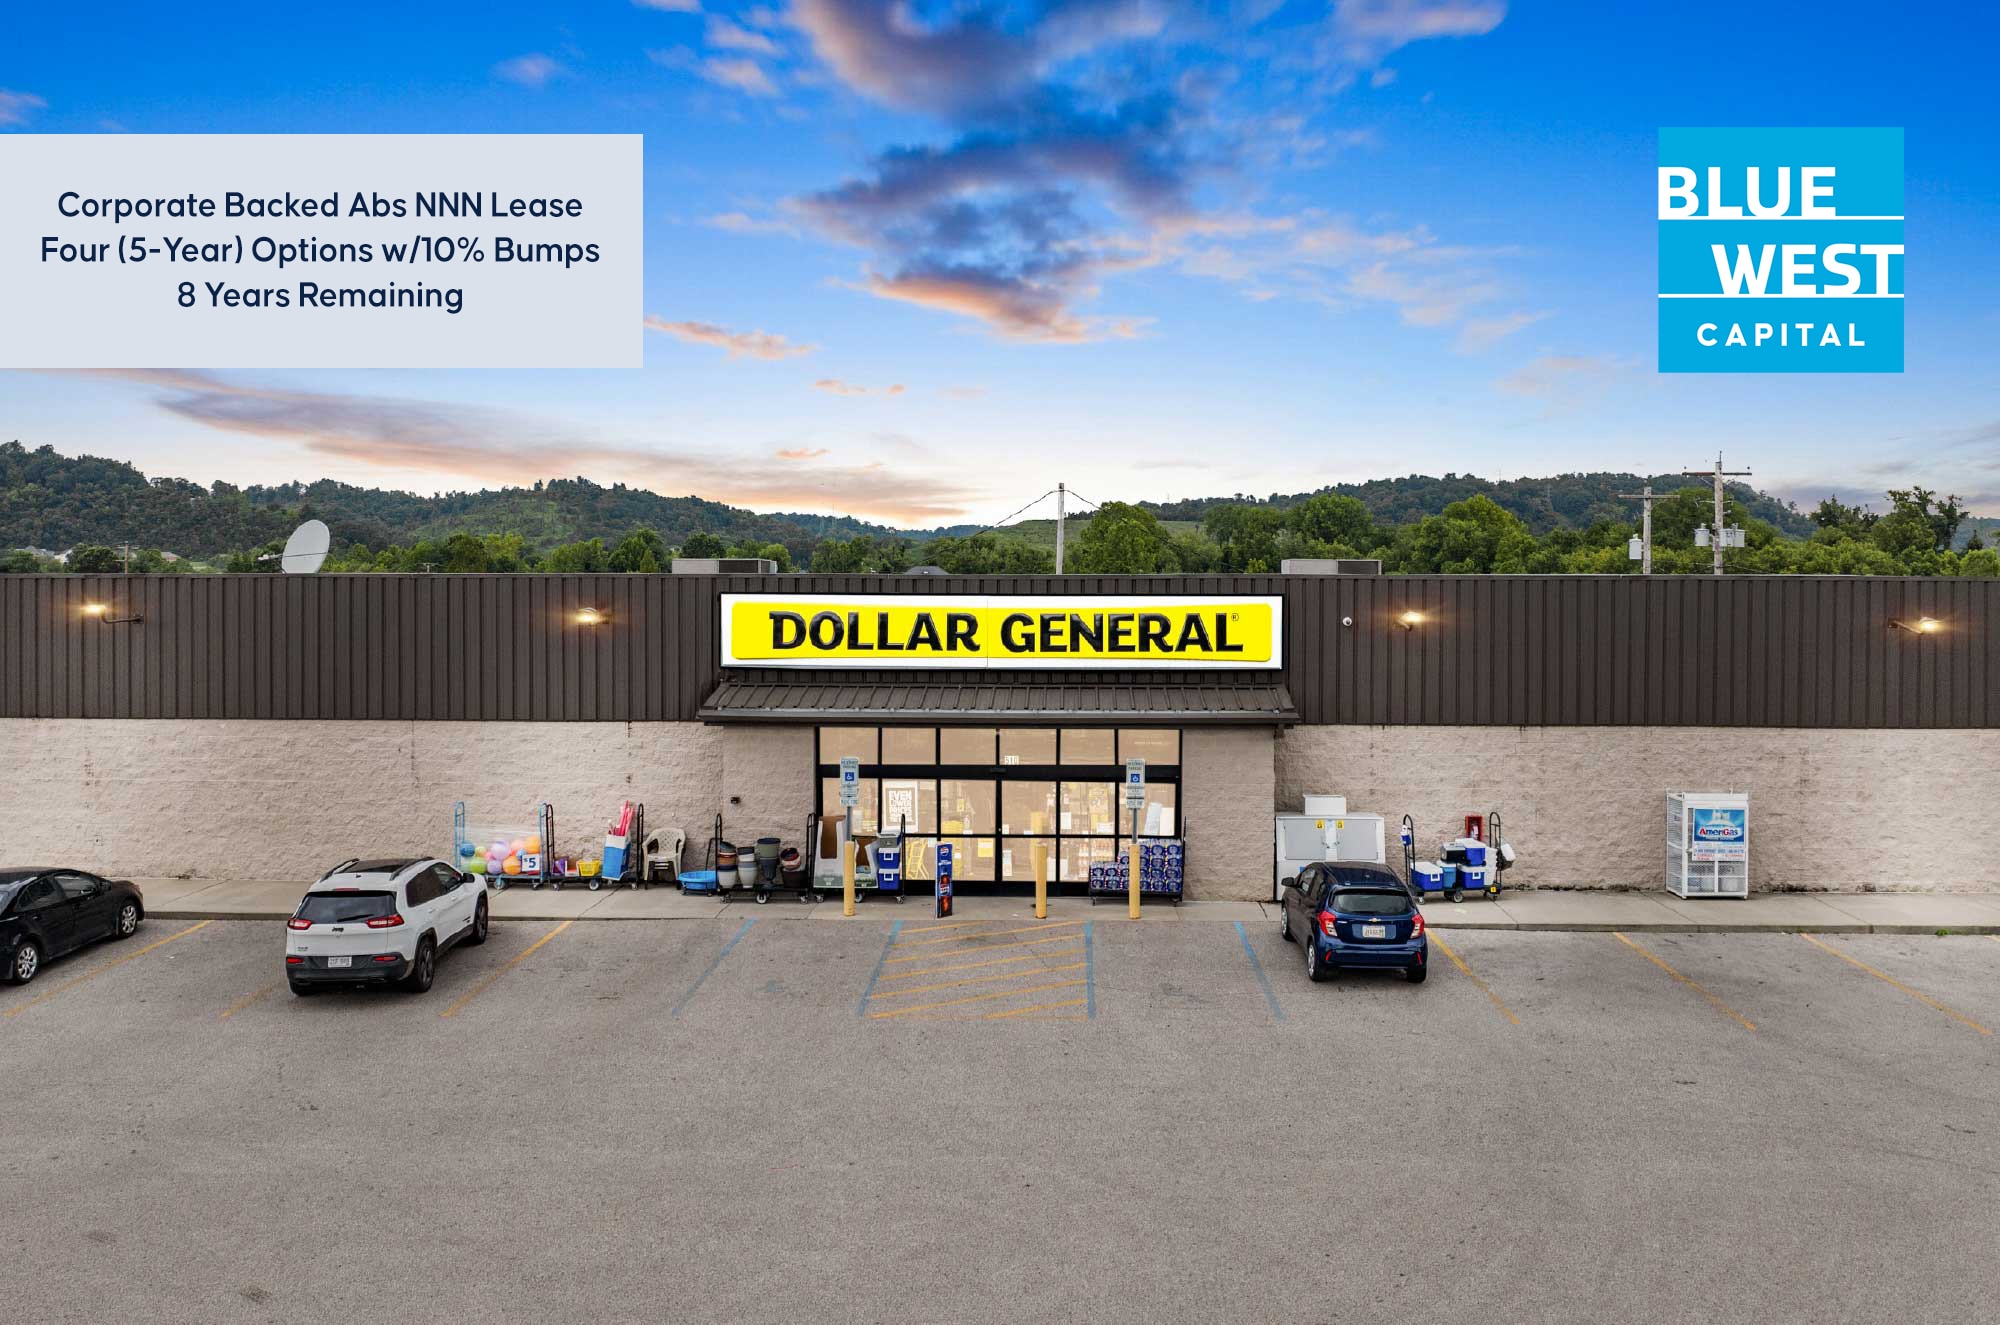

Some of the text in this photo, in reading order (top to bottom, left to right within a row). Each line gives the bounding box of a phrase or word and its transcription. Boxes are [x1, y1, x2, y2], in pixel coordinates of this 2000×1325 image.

[769, 610, 1244, 653] DOLLAR GENERAL
[1699, 827, 1738, 836] AmeriGas
[523, 855, 537, 868] $5
